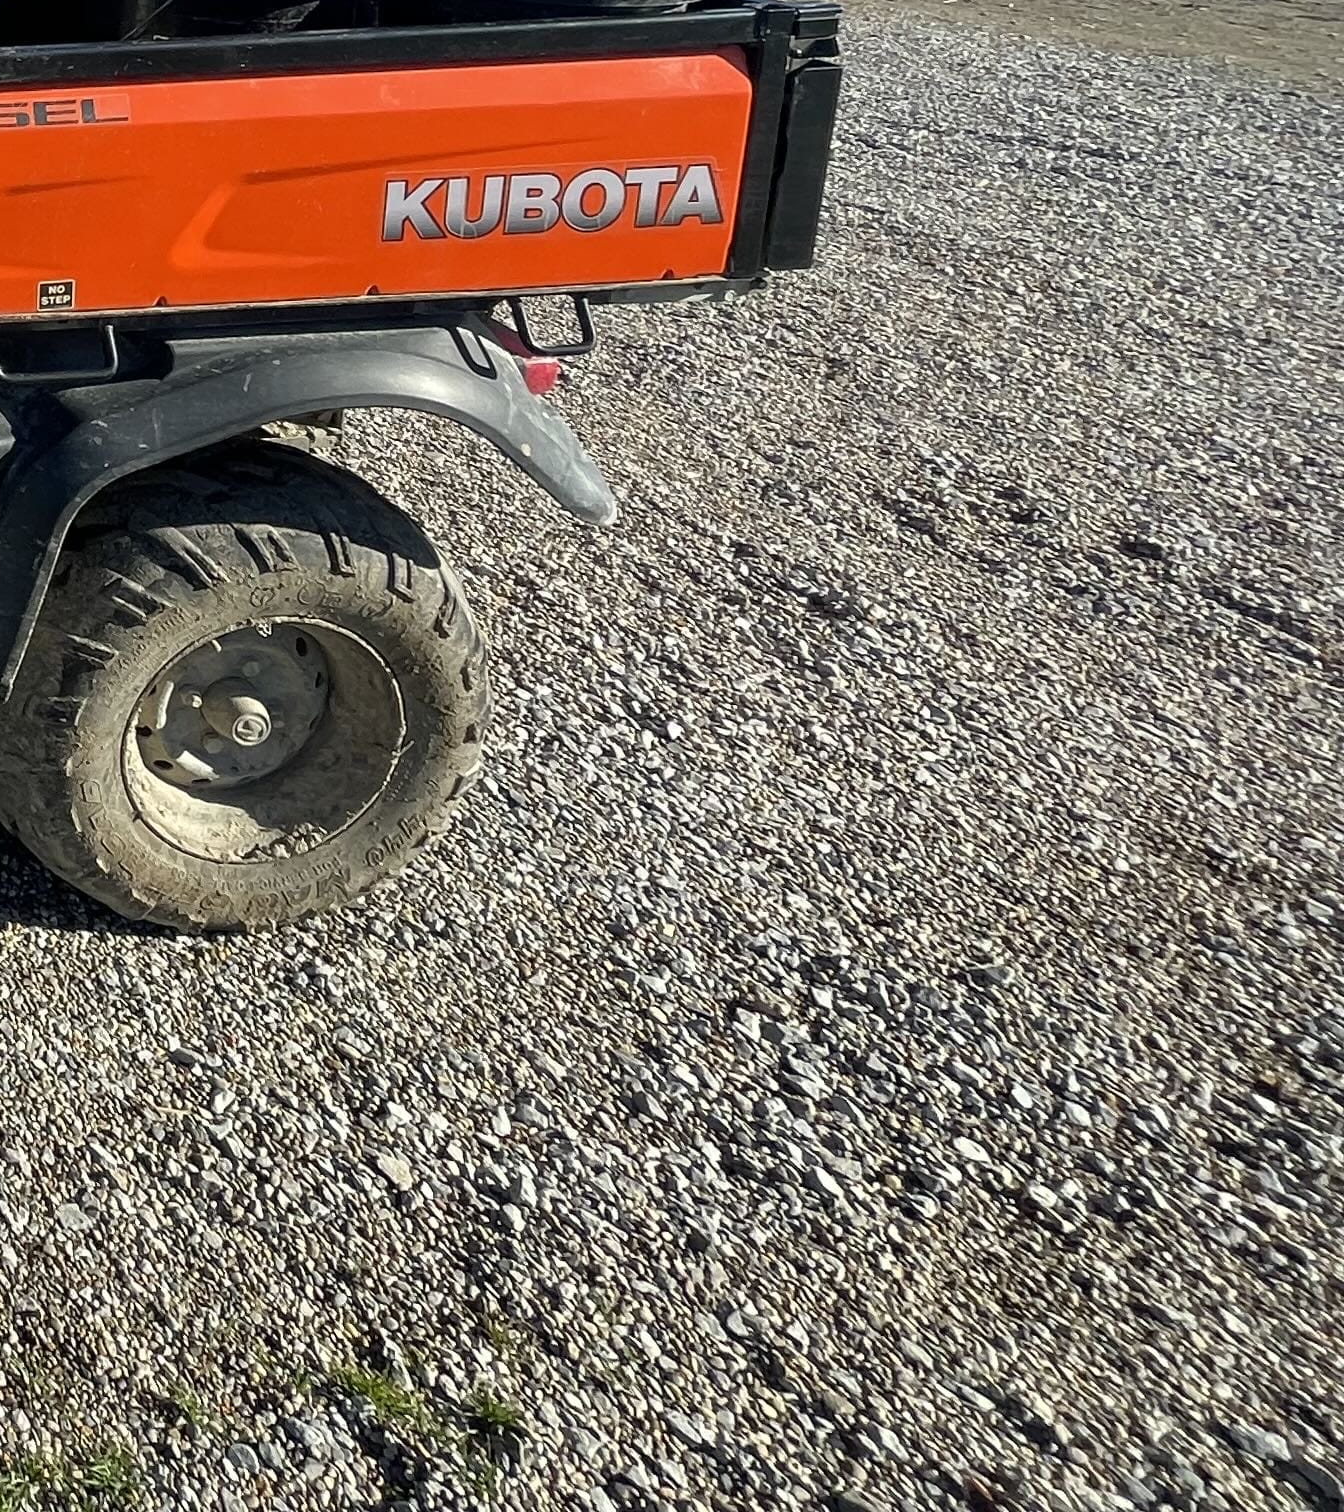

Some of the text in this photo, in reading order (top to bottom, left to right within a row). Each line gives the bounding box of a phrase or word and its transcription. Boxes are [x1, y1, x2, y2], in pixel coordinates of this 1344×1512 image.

[381, 162, 725, 242] KUBOTA
[48, 284, 66, 295] NO
[40, 294, 71, 306] STEP
